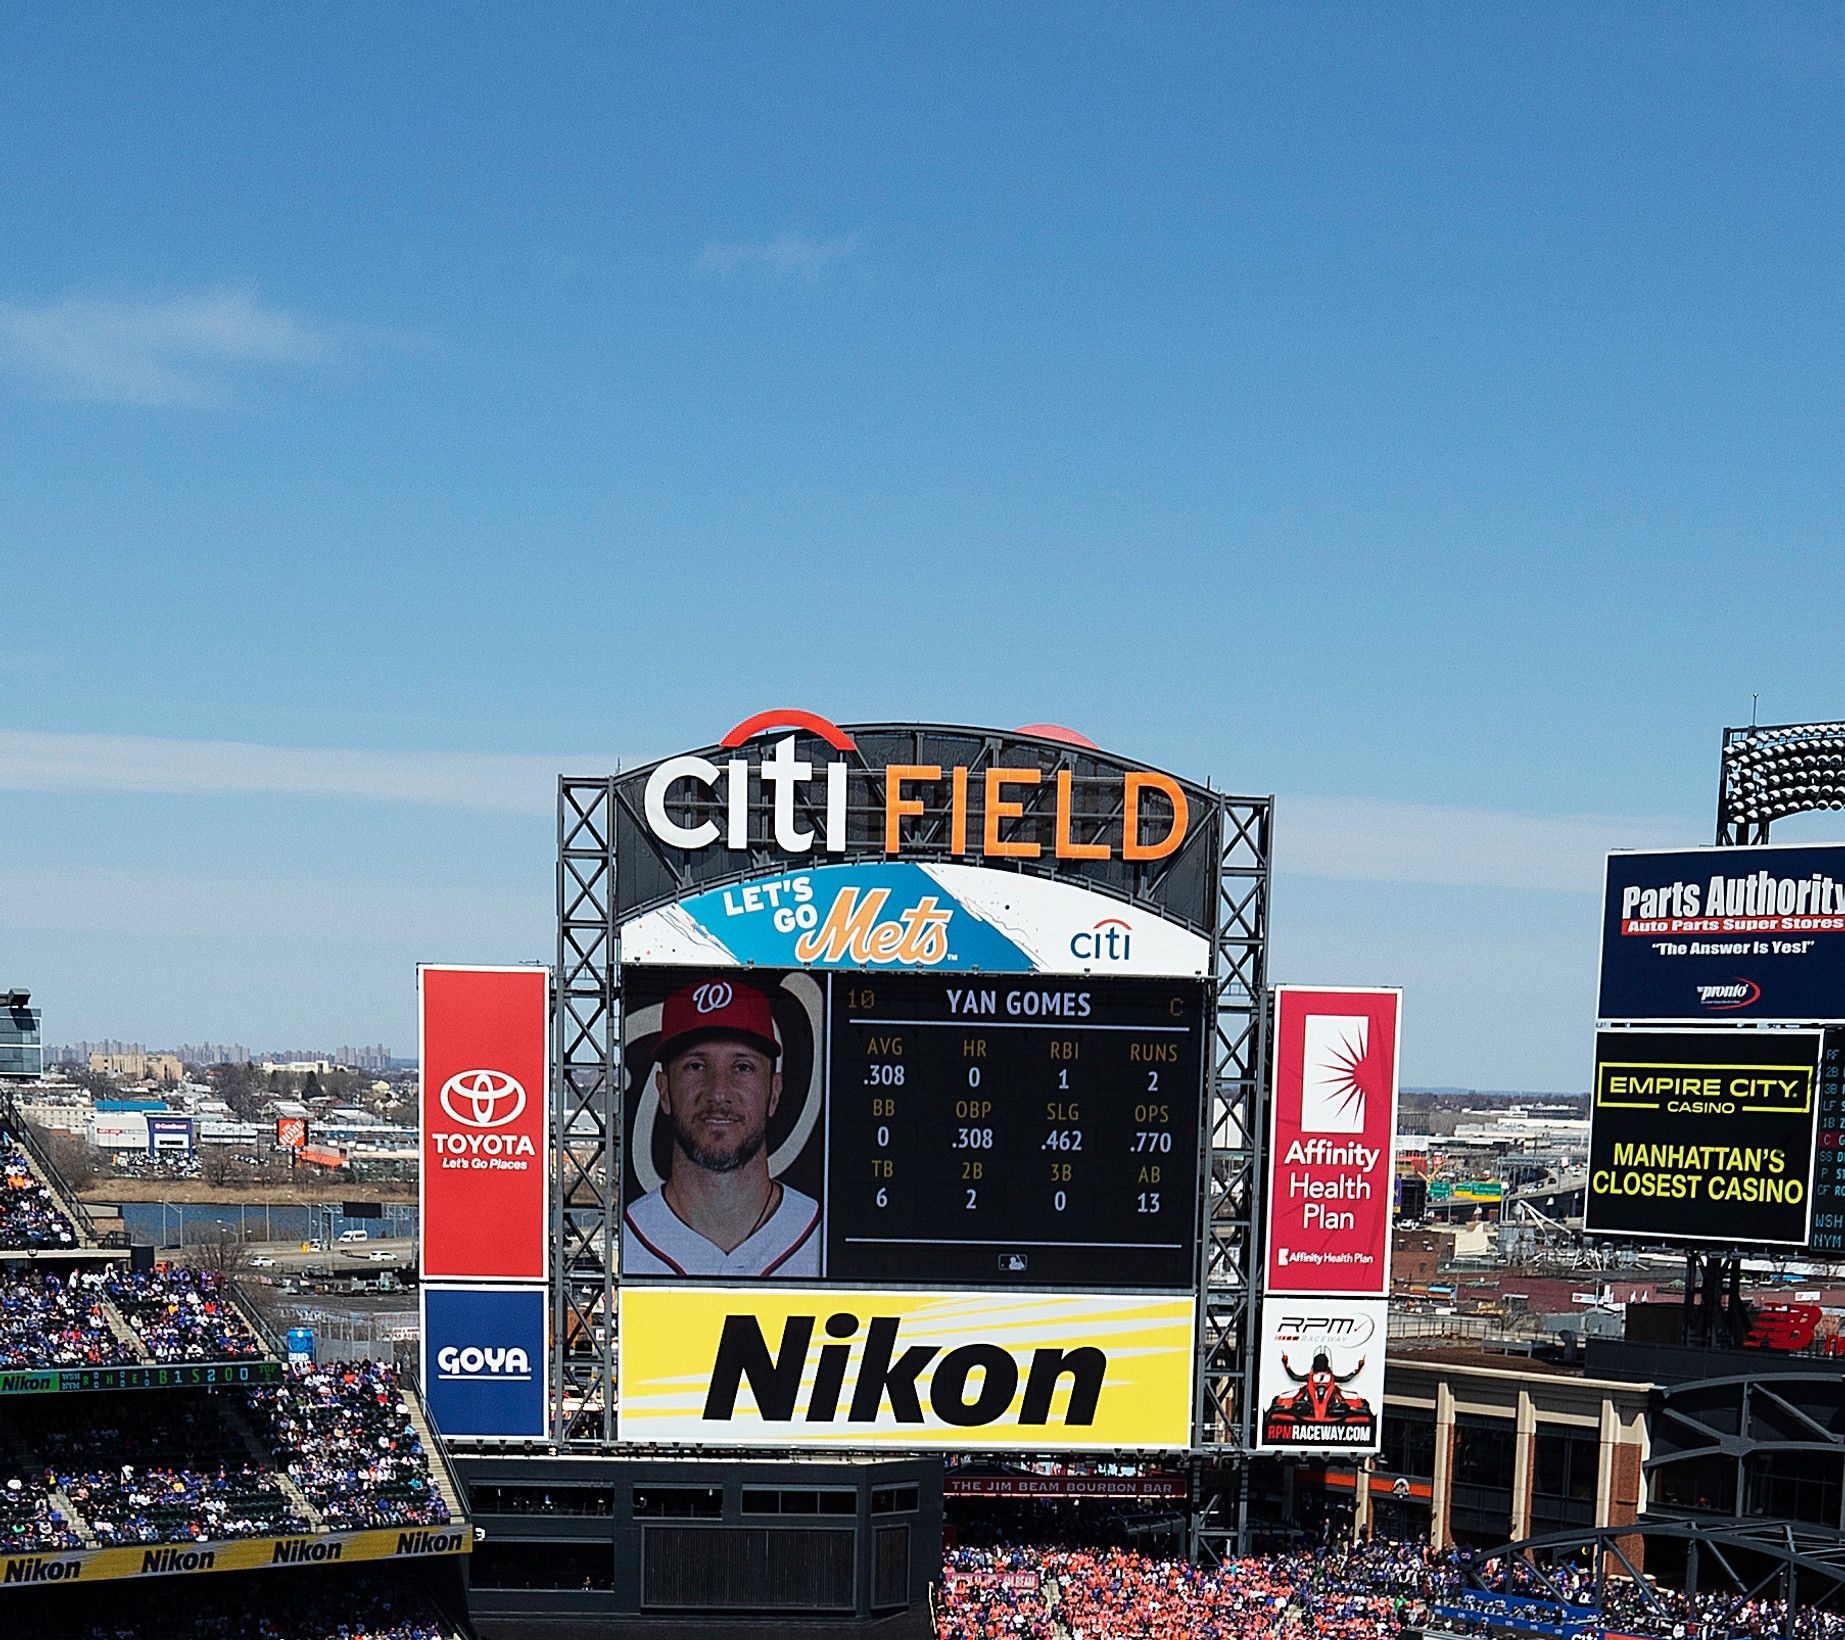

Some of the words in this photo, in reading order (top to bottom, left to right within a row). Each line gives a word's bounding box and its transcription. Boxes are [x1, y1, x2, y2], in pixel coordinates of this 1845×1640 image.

[644, 735, 848, 853] citi
[885, 764, 1189, 860] FIELD
[723, 877, 814, 917] LET'S
[1622, 881, 1701, 919] Parts
[1705, 871, 1845, 917] Authority
[773, 904, 818, 933] GO
[795, 886, 954, 965] Mets
[1628, 920, 1668, 932] Auto
[1671, 919, 1719, 931] Parts
[1723, 918, 1778, 930] Super
[1781, 917, 1844, 929] Stores
[1070, 926, 1130, 961] citi
[1690, 942, 1750, 954] Answer
[1754, 941, 1769, 954] Is
[1699, 984, 1748, 1001] pronto
[848, 990, 875, 1008] 10
[946, 989, 996, 1014] YAN
[1006, 991, 1091, 1017] GOMES
[1169, 998, 1183, 1016] C
[867, 1037, 903, 1056] AVG
[963, 1039, 987, 1057] HR
[1050, 1042, 1079, 1059] RBI
[1130, 1044, 1178, 1062] RUNS
[863, 1065, 905, 1086] .308
[968, 1067, 980, 1087] 0
[1058, 1069, 1069, 1089] 1
[1147, 1071, 1159, 1091] 2
[1610, 1077, 1721, 1096] EMPIRE
[873, 1099, 895, 1117] BB
[956, 1100, 992, 1118] OBP
[1046, 1103, 1079, 1120] SLG
[1134, 1105, 1169, 1122] OPS
[1667, 1101, 1735, 1114] CASINO
[1823, 1100, 1837, 1111] LF
[431, 1133, 536, 1156] TOYOTA
[877, 1126, 889, 1146] 0
[952, 1128, 993, 1149] .308
[1041, 1130, 1082, 1151] .462
[1129, 1132, 1172, 1153] .770
[442, 1157, 469, 1169] Let's
[471, 1158, 488, 1169] Go
[489, 1158, 527, 1170] Places
[1284, 1140, 1380, 1174] Affinity
[1613, 1143, 1785, 1173] MANHATTAN'S
[1820, 1150, 1833, 1162] SS
[871, 1160, 893, 1177] TB
[962, 1162, 983, 1180] 2B
[1051, 1164, 1072, 1182] 3B
[1138, 1166, 1161, 1184] AB
[1289, 1172, 1371, 1201] Health
[1592, 1170, 1702, 1199] CLOSEST
[1707, 1176, 1804, 1205] CASINO
[876, 1187, 888, 1207] 6
[966, 1189, 977, 1209] 2
[1054, 1191, 1066, 1211] 0
[1137, 1193, 1160, 1213] 13
[1303, 1203, 1354, 1230] Plan
[1815, 1213, 1843, 1229] WSH
[1813, 1233, 1842, 1248] NYM
[1289, 1252, 1323, 1265] Affinity
[1323, 1252, 1353, 1263] Health
[1354, 1253, 1374, 1263] Plan
[1277, 1317, 1355, 1334] RPM
[438, 1346, 529, 1374] GOYA
[702, 1313, 1107, 1427] Nikon
[2, 1375, 50, 1392] Nikon
[1267, 1425, 1371, 1441] RPMRACEWAY.COM
[951, 1481, 981, 1491] THE
[987, 1481, 1012, 1491] JIM
[1018, 1482, 1059, 1492] BEAM
[1066, 1482, 1136, 1492] BOURBON
[1143, 1483, 1173, 1493] BAR
[272, 1541, 342, 1563] Nikon
[397, 1531, 463, 1554] Nikon
[3, 1560, 82, 1583] Nikon
[141, 1550, 215, 1573] Nikon
